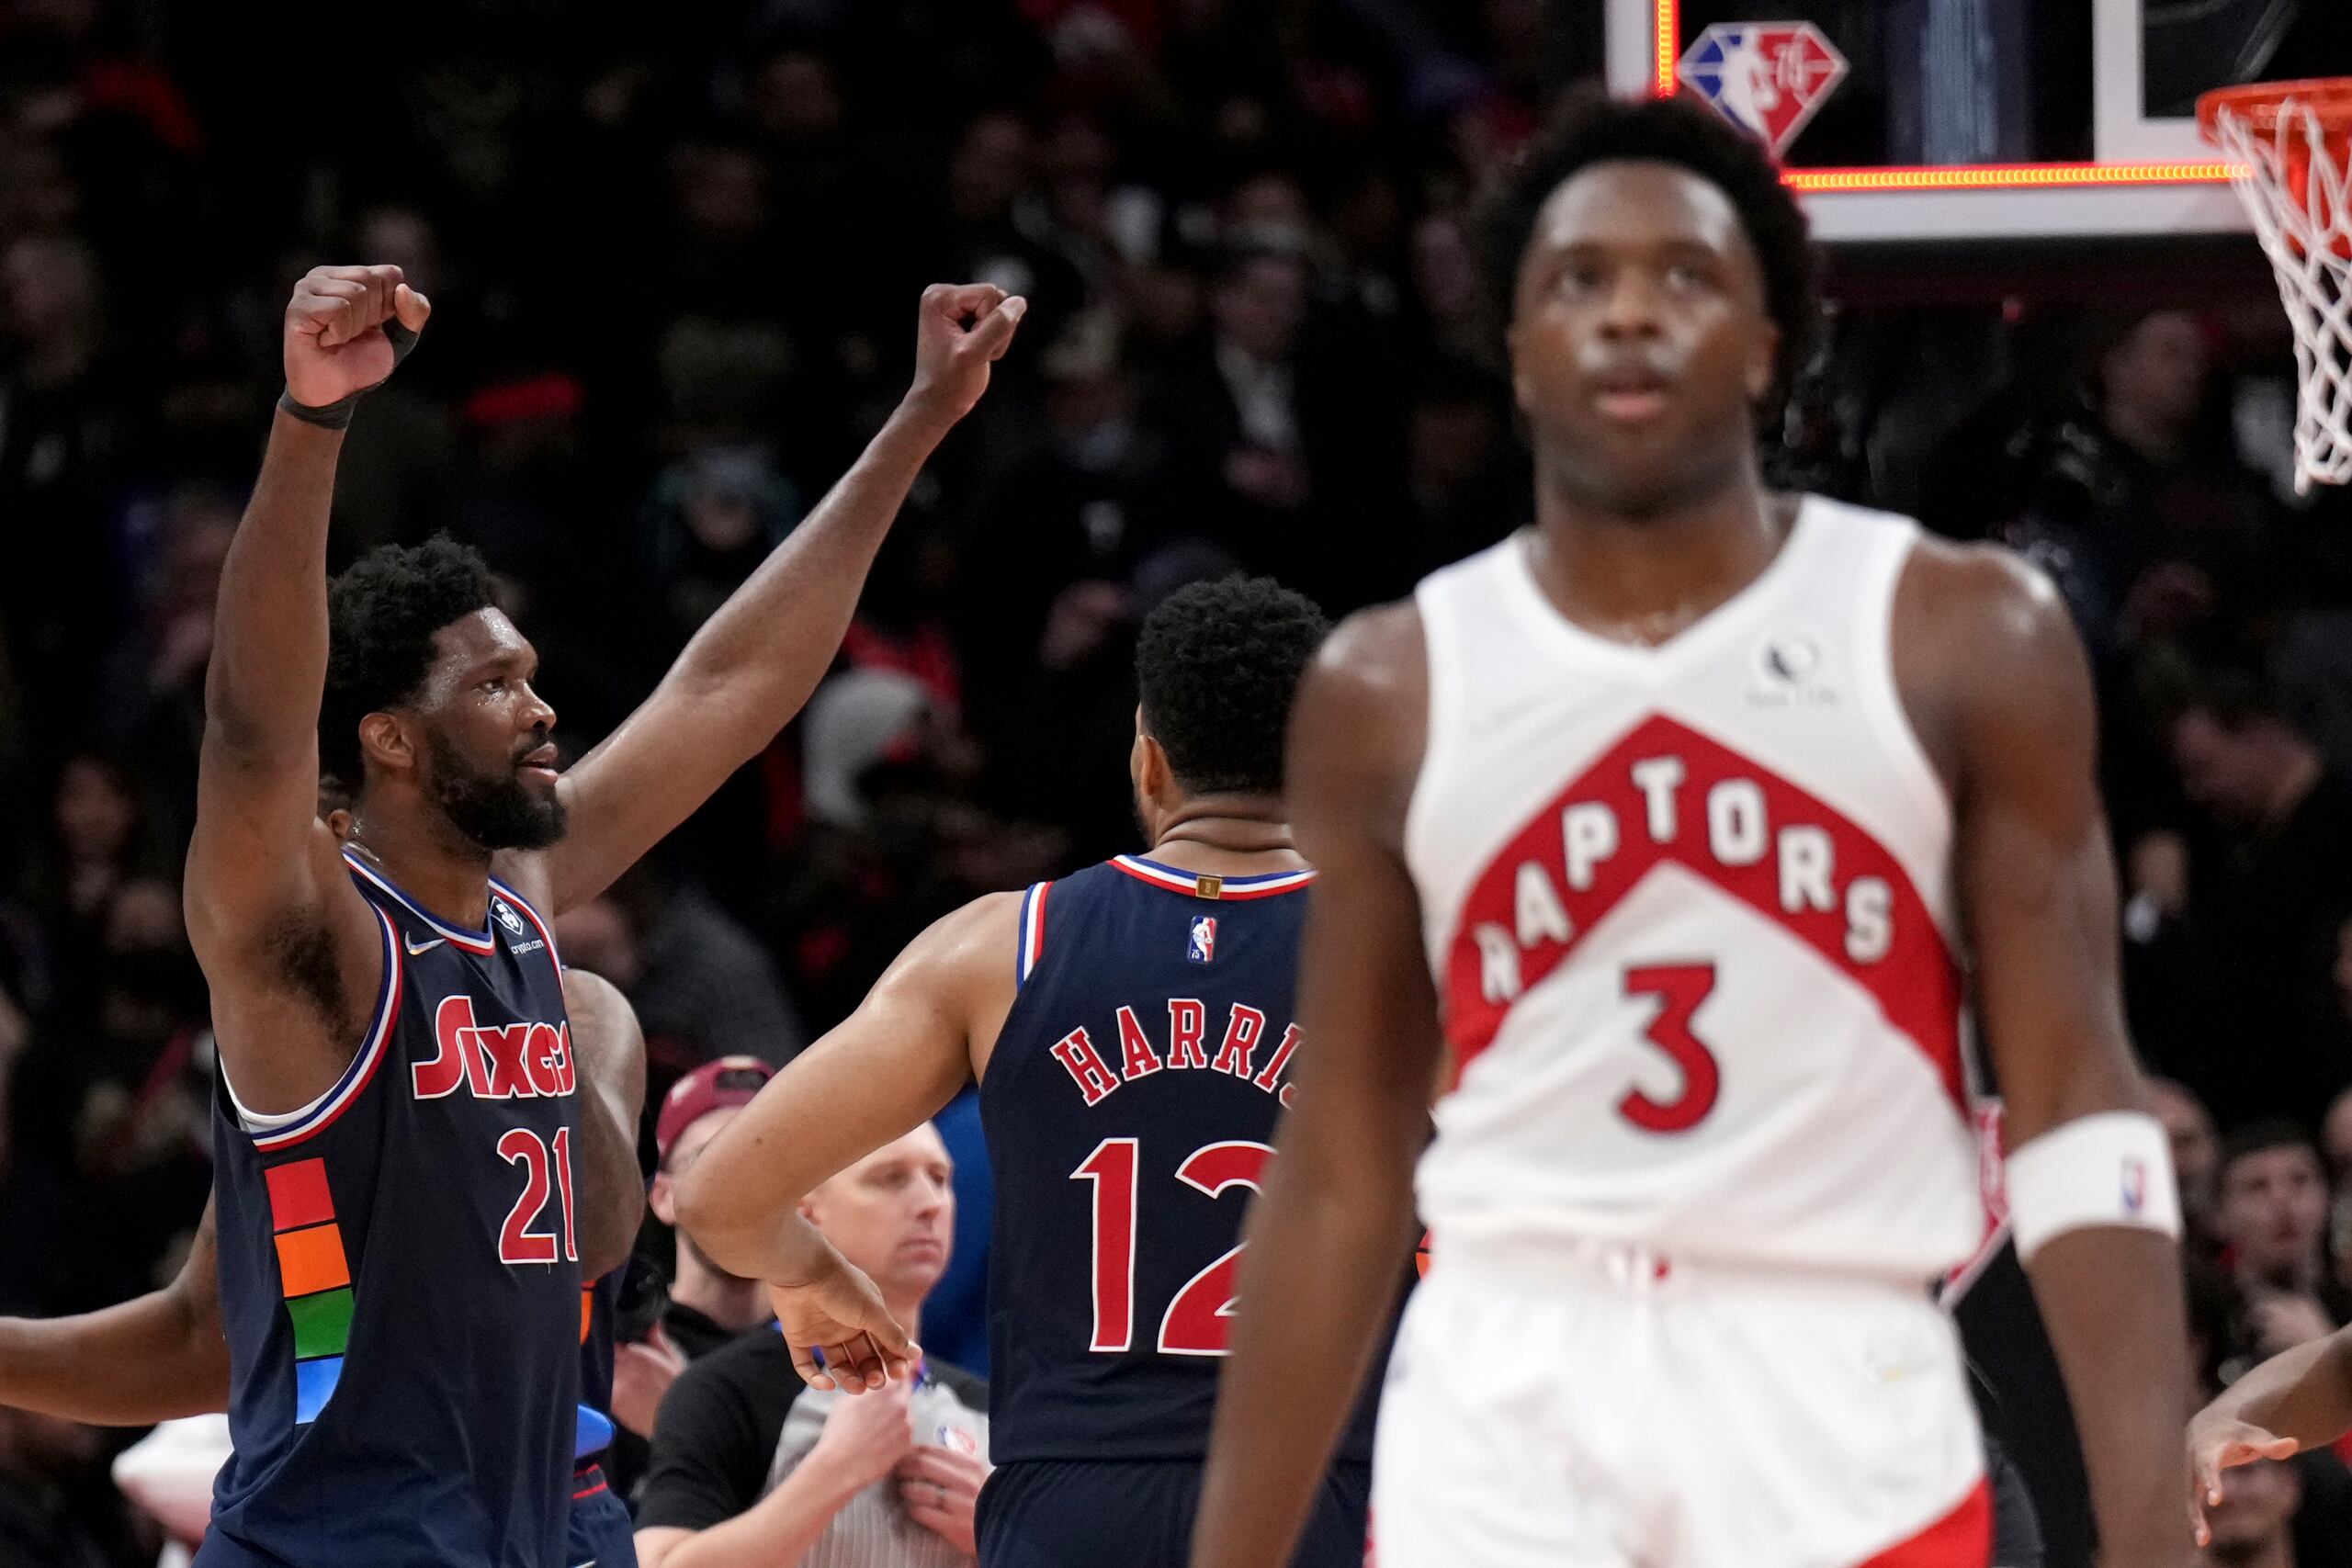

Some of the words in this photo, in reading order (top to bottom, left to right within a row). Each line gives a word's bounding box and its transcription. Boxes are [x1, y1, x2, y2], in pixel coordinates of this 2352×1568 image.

[1474, 755, 1893, 1005] RAPTORS
[1049, 998, 1305, 1110] HARRI
[1617, 959, 1719, 1136] 3
[496, 1126, 578, 1264] 21
[1069, 1137, 1280, 1356] 12
